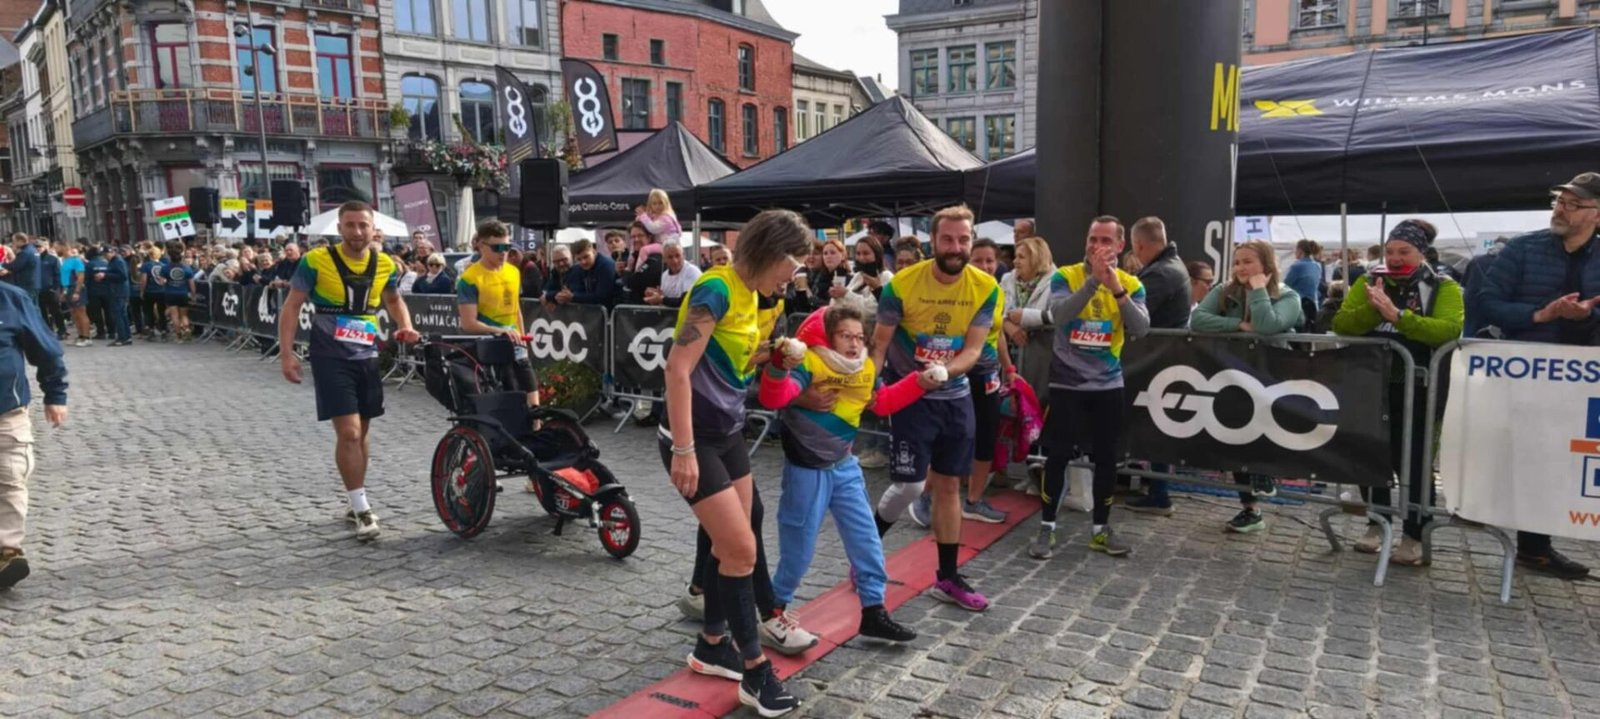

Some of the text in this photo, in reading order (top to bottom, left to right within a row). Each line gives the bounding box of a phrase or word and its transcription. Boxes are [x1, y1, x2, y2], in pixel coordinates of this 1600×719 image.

[574, 77, 604, 137] GOC
[1483, 80, 1586, 98] MONS
[505, 86, 527, 137] GOC
[415, 313, 462, 328] OMNIACA
[529, 318, 588, 363] GOC
[628, 327, 676, 371] GO
[1468, 355, 1600, 383] PROFESS
[1133, 364, 1340, 450] GOC
